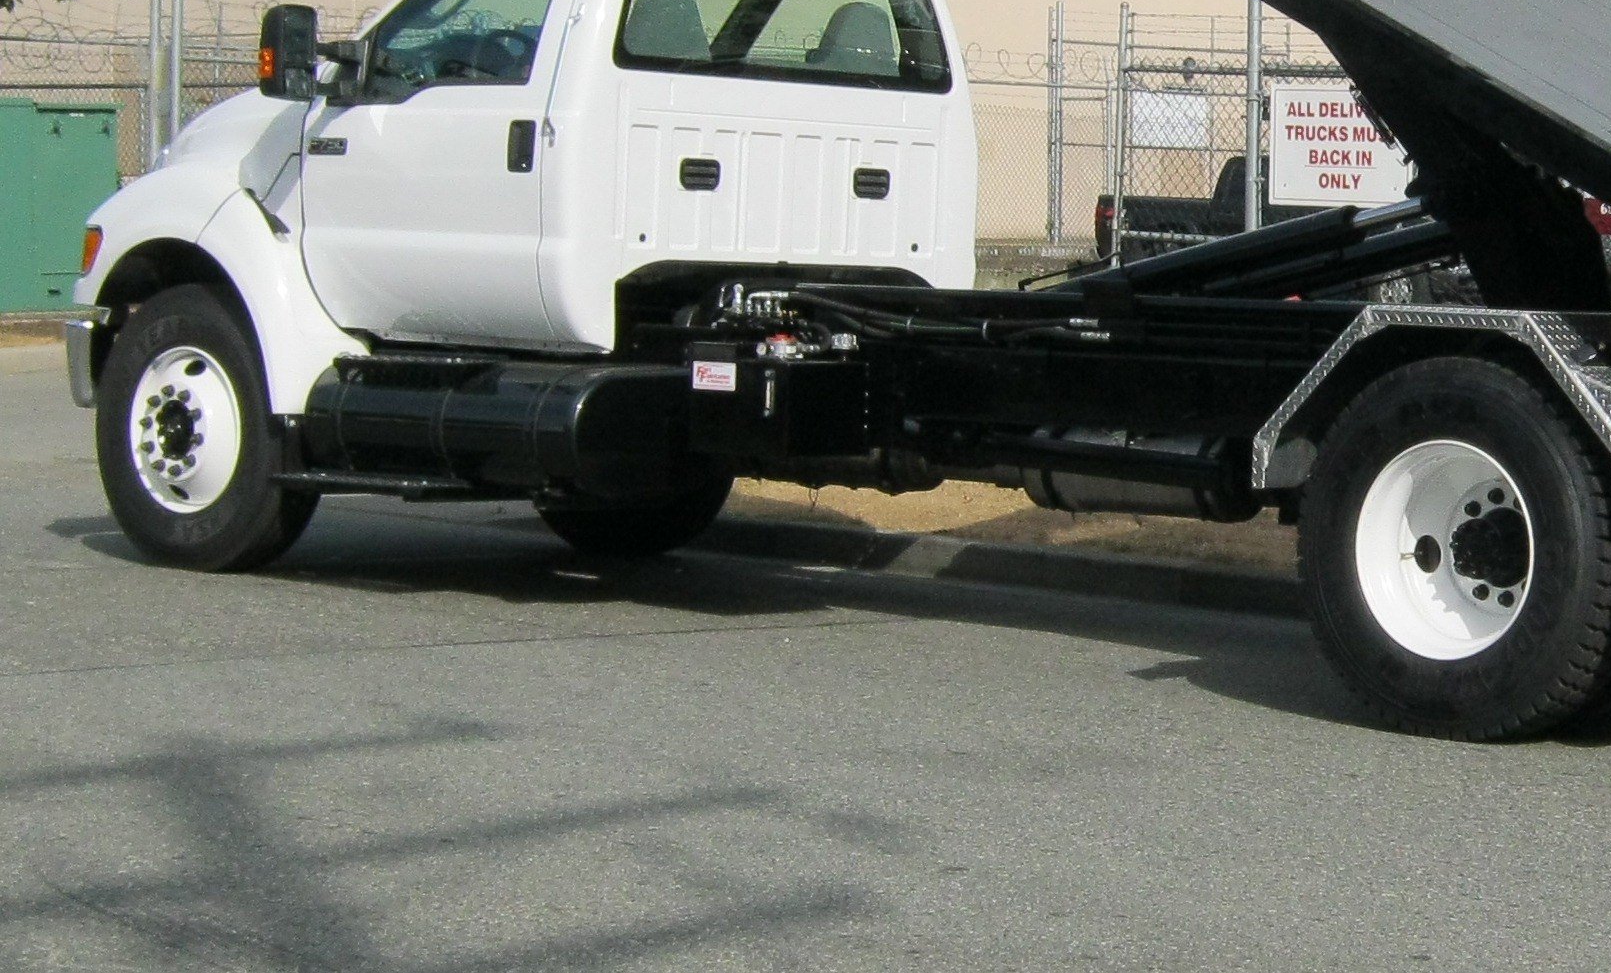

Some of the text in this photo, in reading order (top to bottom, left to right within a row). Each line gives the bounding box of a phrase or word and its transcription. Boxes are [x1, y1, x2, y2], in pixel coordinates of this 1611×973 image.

[1286, 102, 1365, 119] ALL DELIV
[1285, 125, 1387, 143] TRUCKS MU
[1309, 149, 1373, 166] BACK IN
[1318, 173, 1362, 190] ONLY
